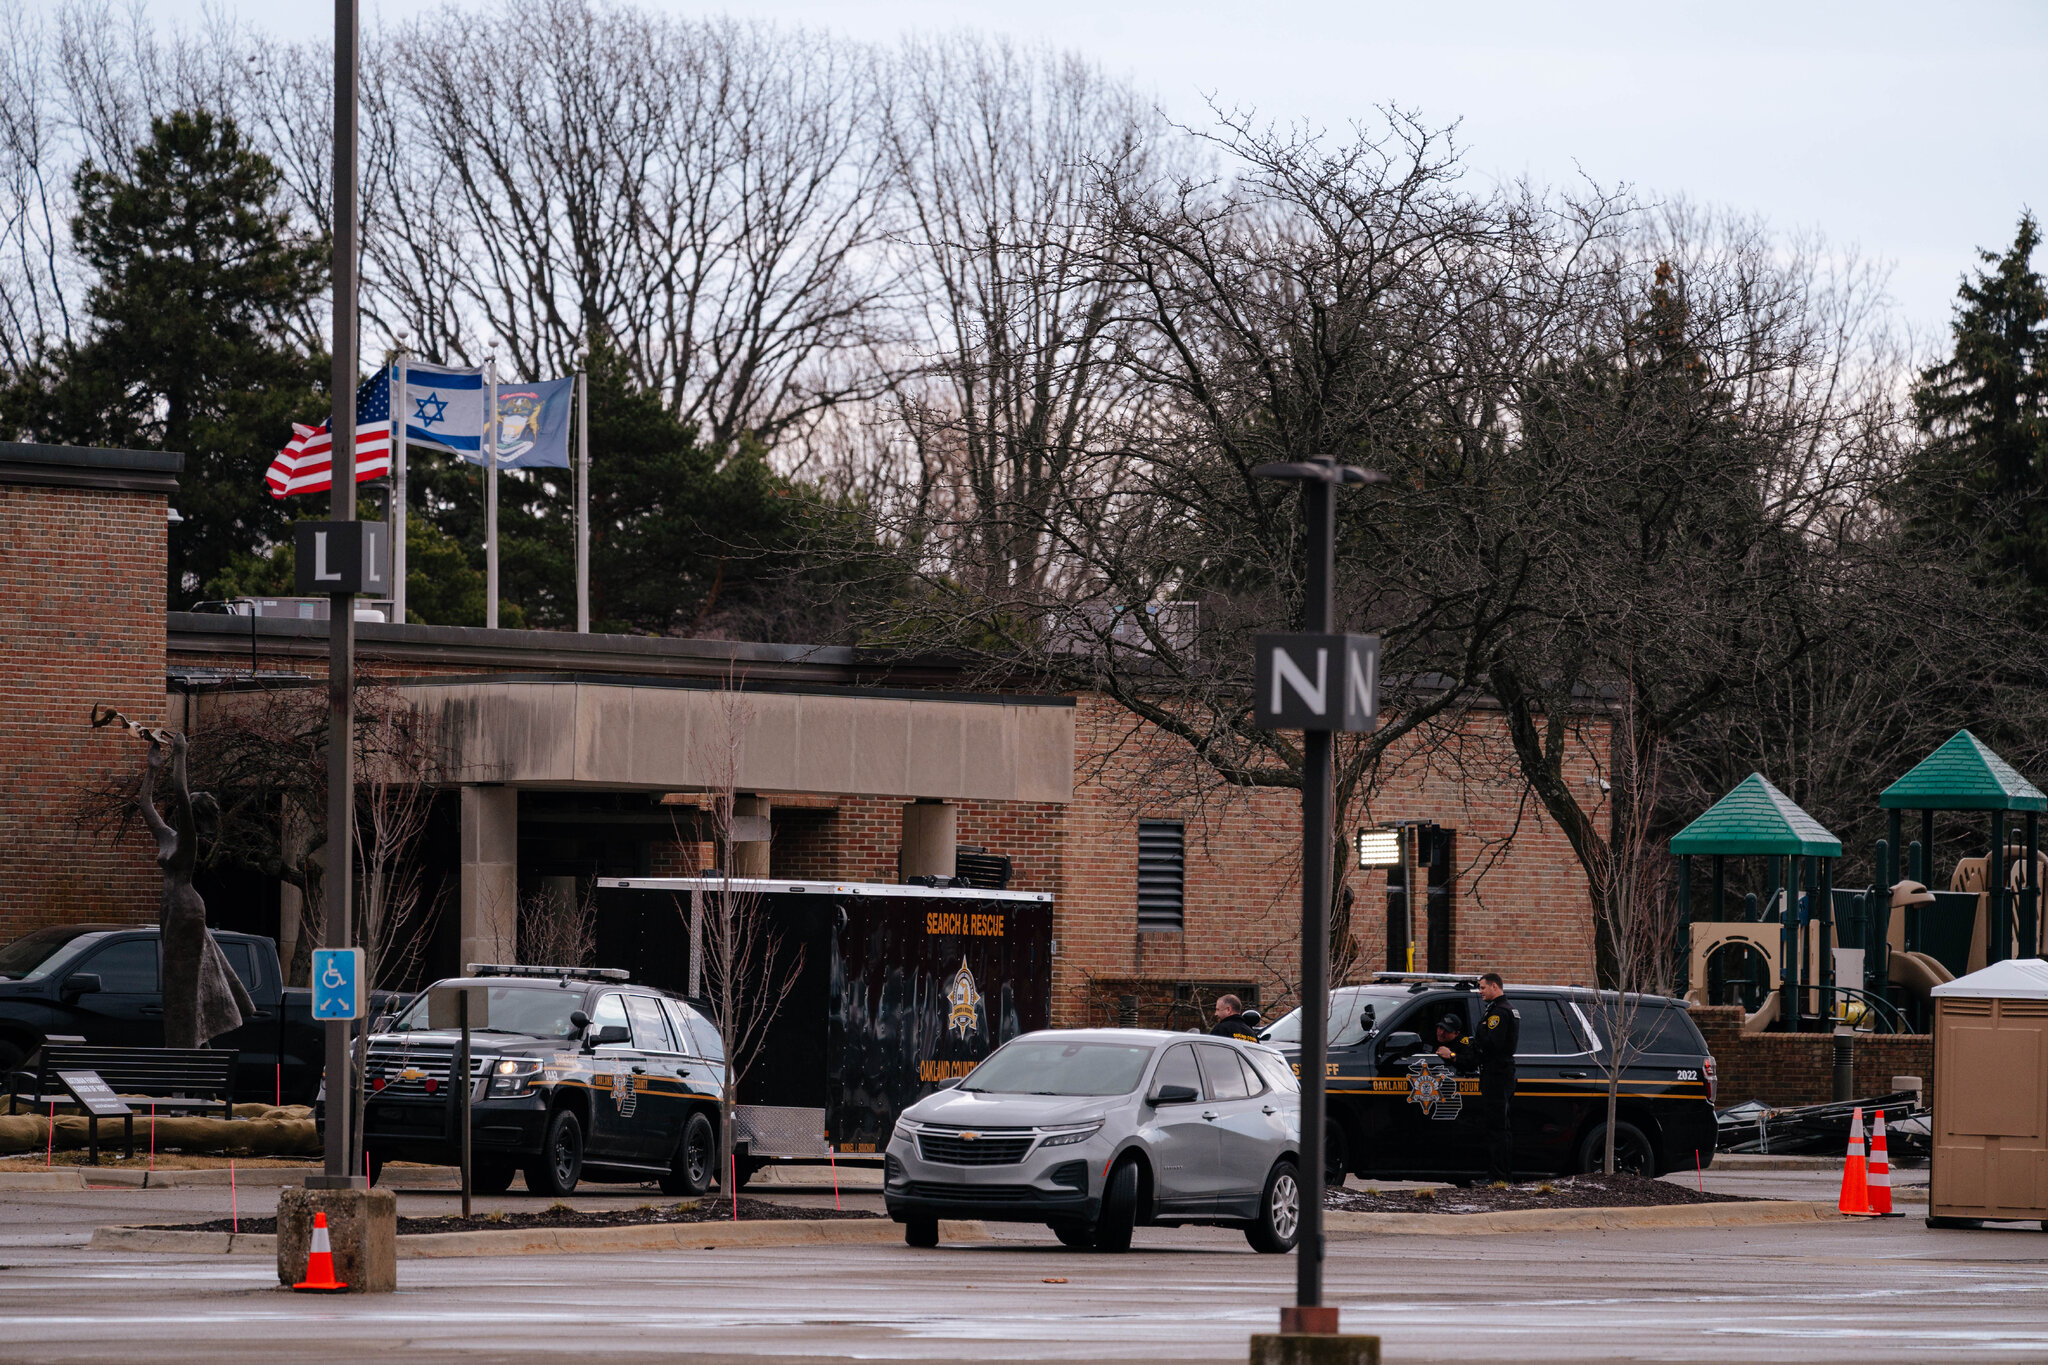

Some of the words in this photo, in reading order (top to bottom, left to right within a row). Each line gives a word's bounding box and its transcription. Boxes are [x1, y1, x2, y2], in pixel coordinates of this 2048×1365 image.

[315, 531, 342, 581] L
[369, 532, 380, 582] L
[1271, 647, 1328, 715] N
[1349, 649, 1374, 717] N
[926, 912, 961, 935] SEARCH
[962, 913, 969, 936] &
[970, 914, 1005, 937] RESCUE
[920, 1060, 951, 1081] OAKLAND
[1373, 1081, 1409, 1091] OAKLAND
[1459, 1082, 1480, 1092] COUN
[1677, 1070, 1698, 1080] 2022
